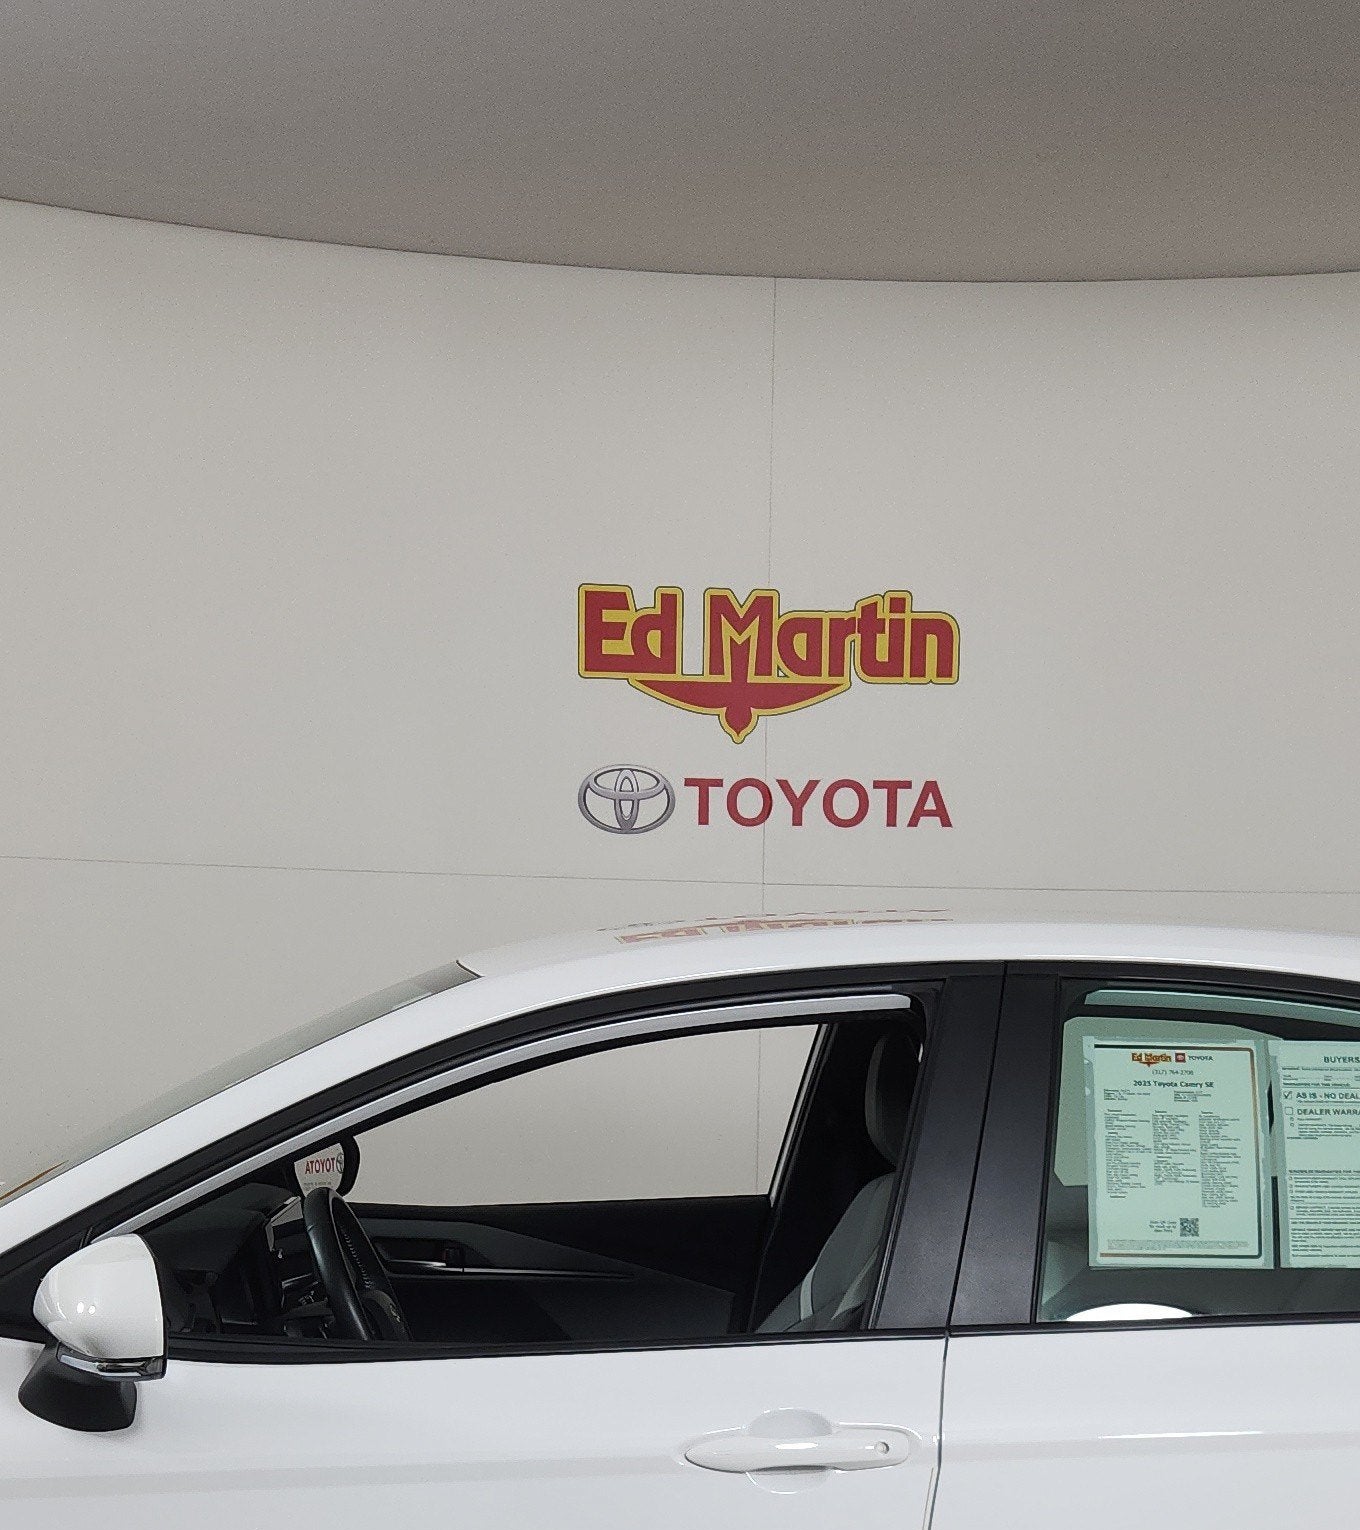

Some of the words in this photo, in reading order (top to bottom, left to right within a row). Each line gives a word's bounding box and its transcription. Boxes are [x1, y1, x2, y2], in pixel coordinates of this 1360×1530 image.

[578, 584, 683, 678] Ed
[703, 588, 960, 684] Martin
[684, 777, 953, 829] TOYOTA
[1323, 1056, 1360, 1064] BUYERS
[1153, 1080, 1178, 1088] Toyota
